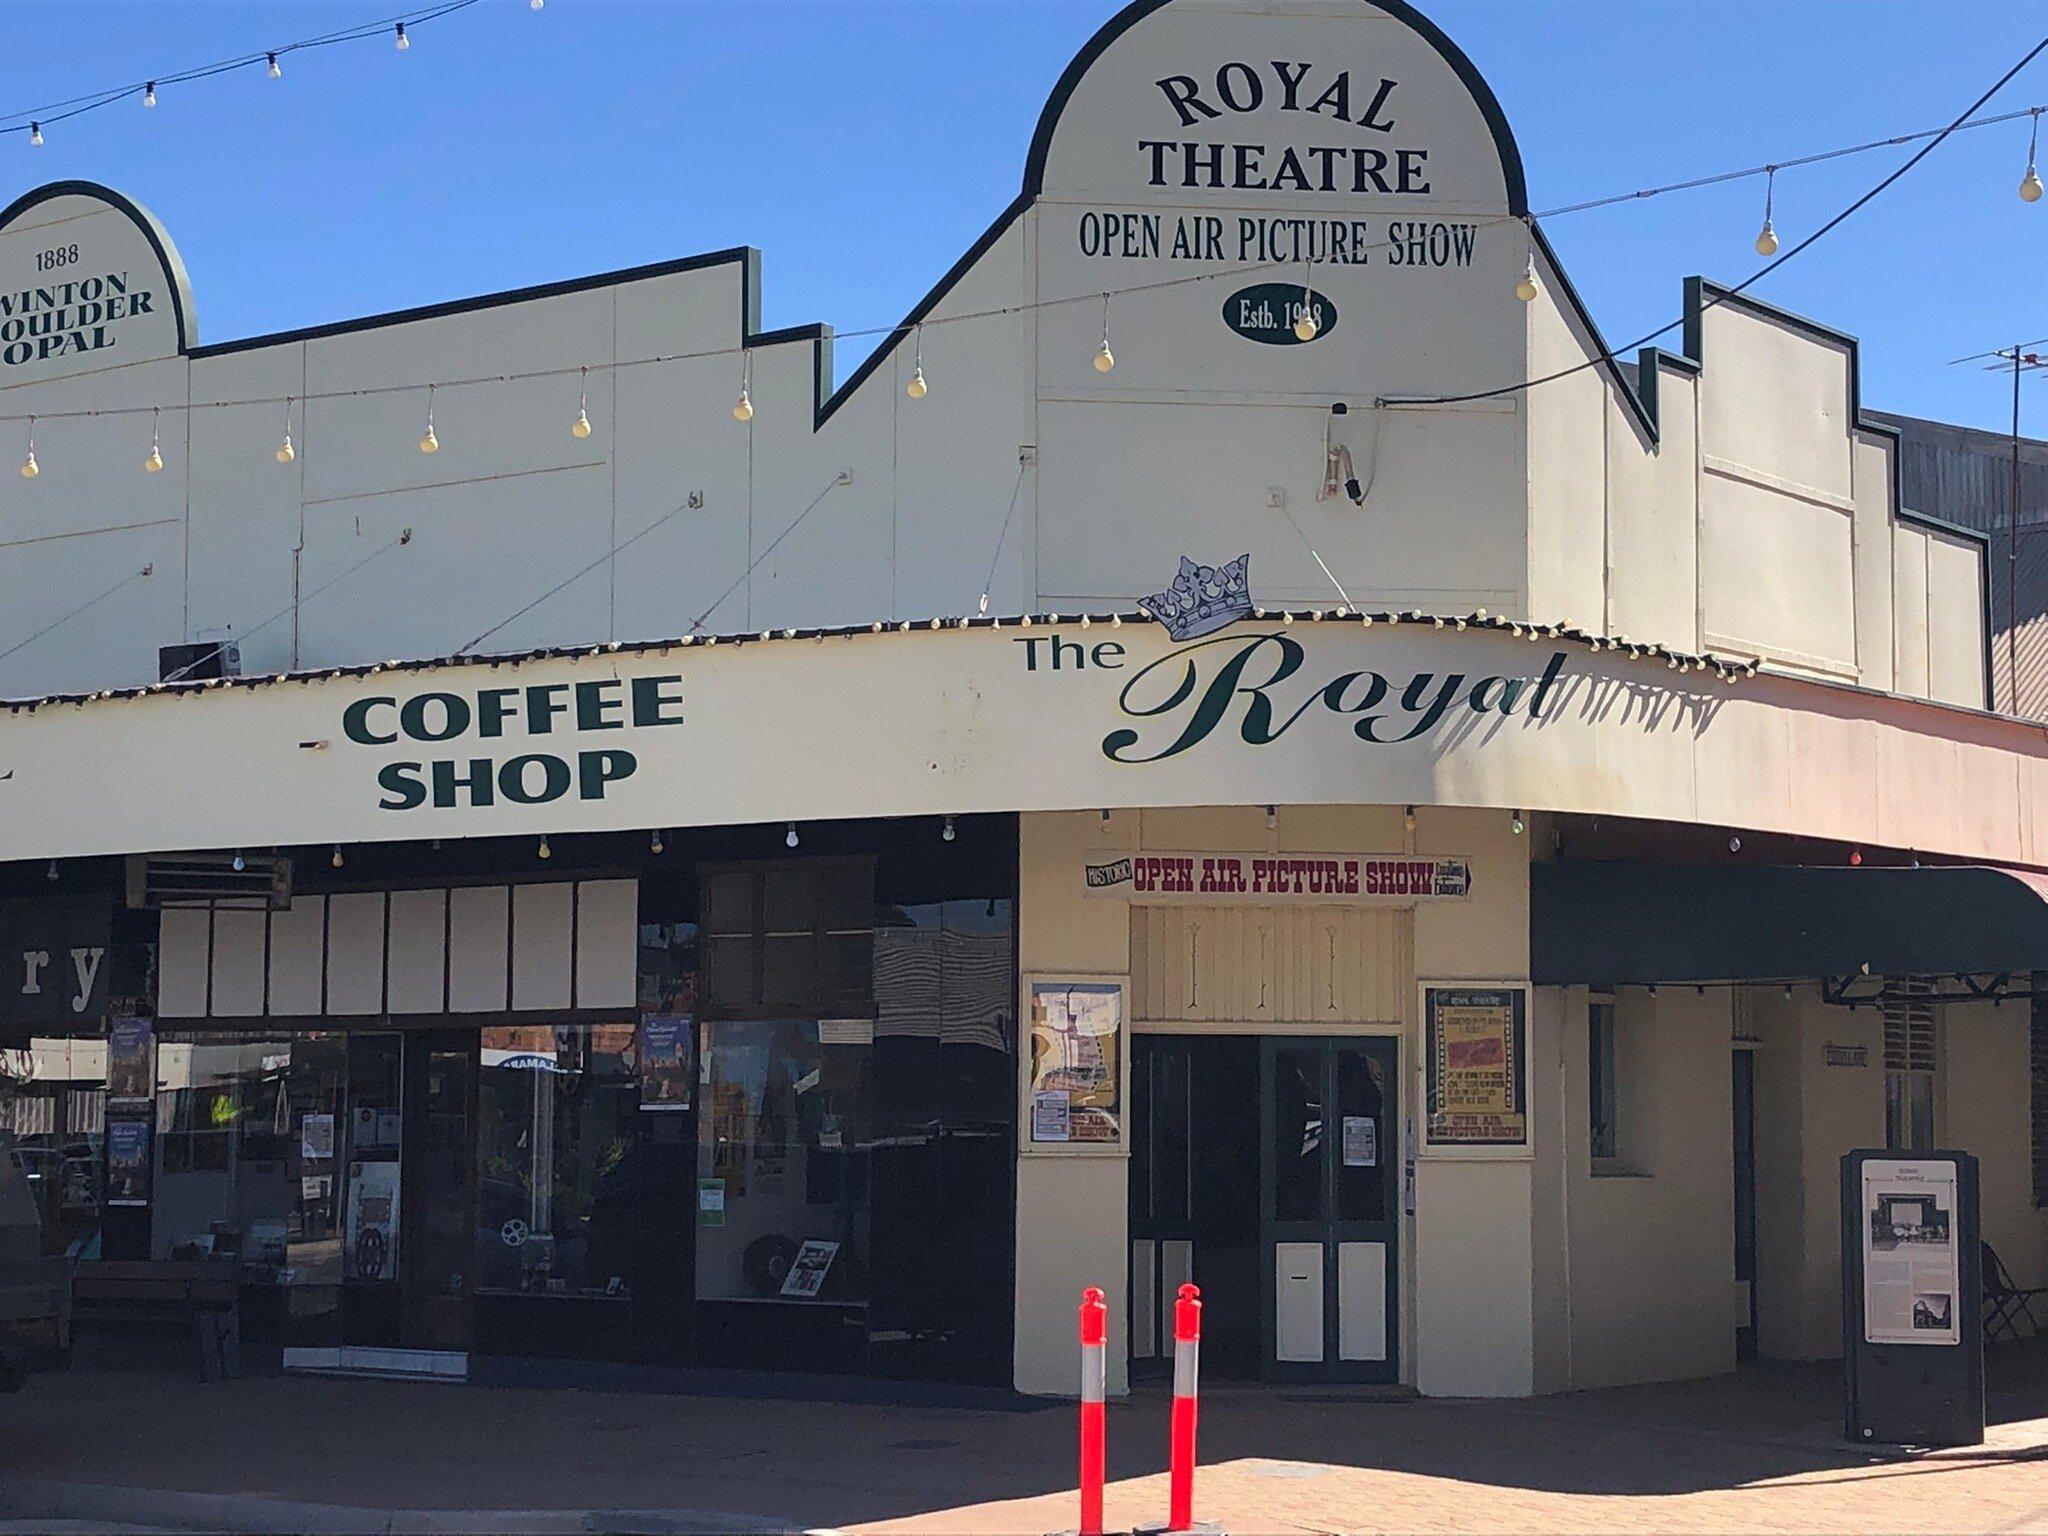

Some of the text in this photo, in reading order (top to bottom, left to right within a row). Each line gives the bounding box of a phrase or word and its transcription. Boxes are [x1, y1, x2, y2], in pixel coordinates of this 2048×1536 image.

[1156, 60, 1398, 134] ROYAL
[1138, 140, 1431, 195] THEATRE
[36, 243, 79, 272] 1888
[1079, 211, 1477, 268] OPEN AIR PICTURE SHOW
[1239, 299, 1322, 332] Estb. 198
[3, 325, 116, 365] OPAL
[1013, 634, 1125, 671] The
[342, 675, 684, 746] COFFEE
[1101, 631, 1567, 763] Royal
[378, 749, 638, 811] SHOP
[1134, 858, 1194, 892] OPEN
[1200, 859, 1247, 893] AIR
[1253, 859, 1359, 894] PICTURE
[1366, 861, 1434, 895] SHOW
